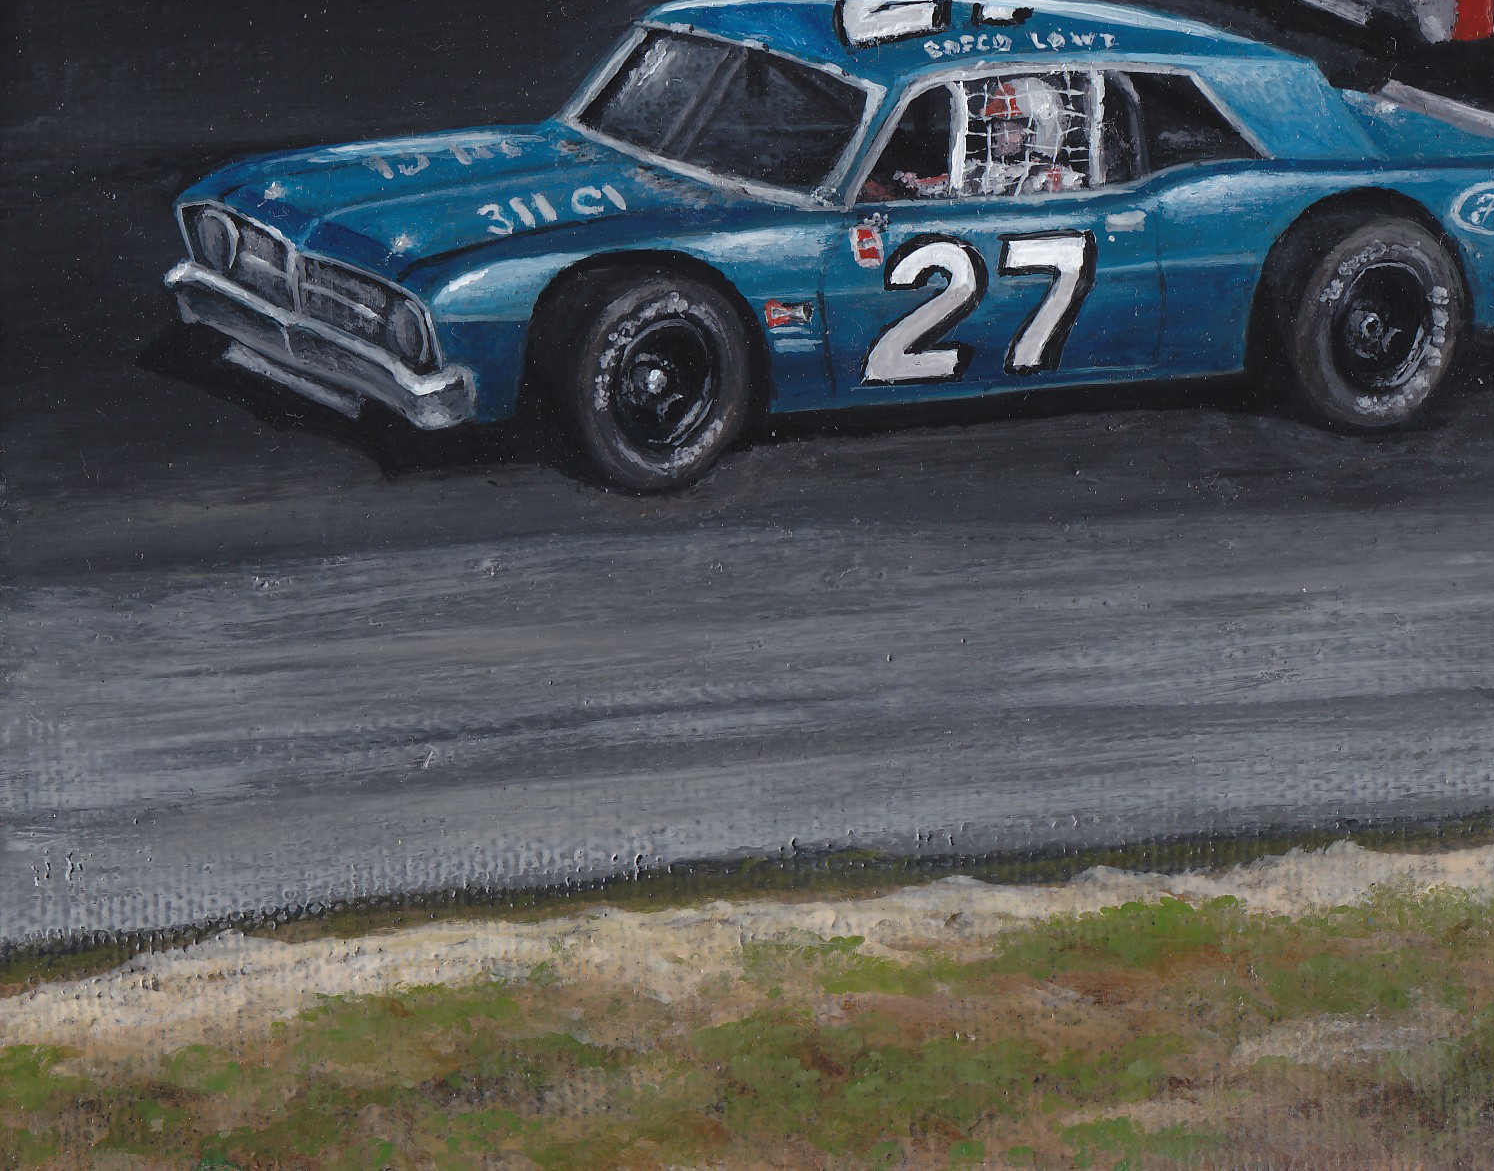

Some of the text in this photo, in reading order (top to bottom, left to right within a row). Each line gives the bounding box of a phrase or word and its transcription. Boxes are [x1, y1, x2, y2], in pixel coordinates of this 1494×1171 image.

[476, 184, 628, 235] 311 CI
[860, 231, 1098, 385] 27
